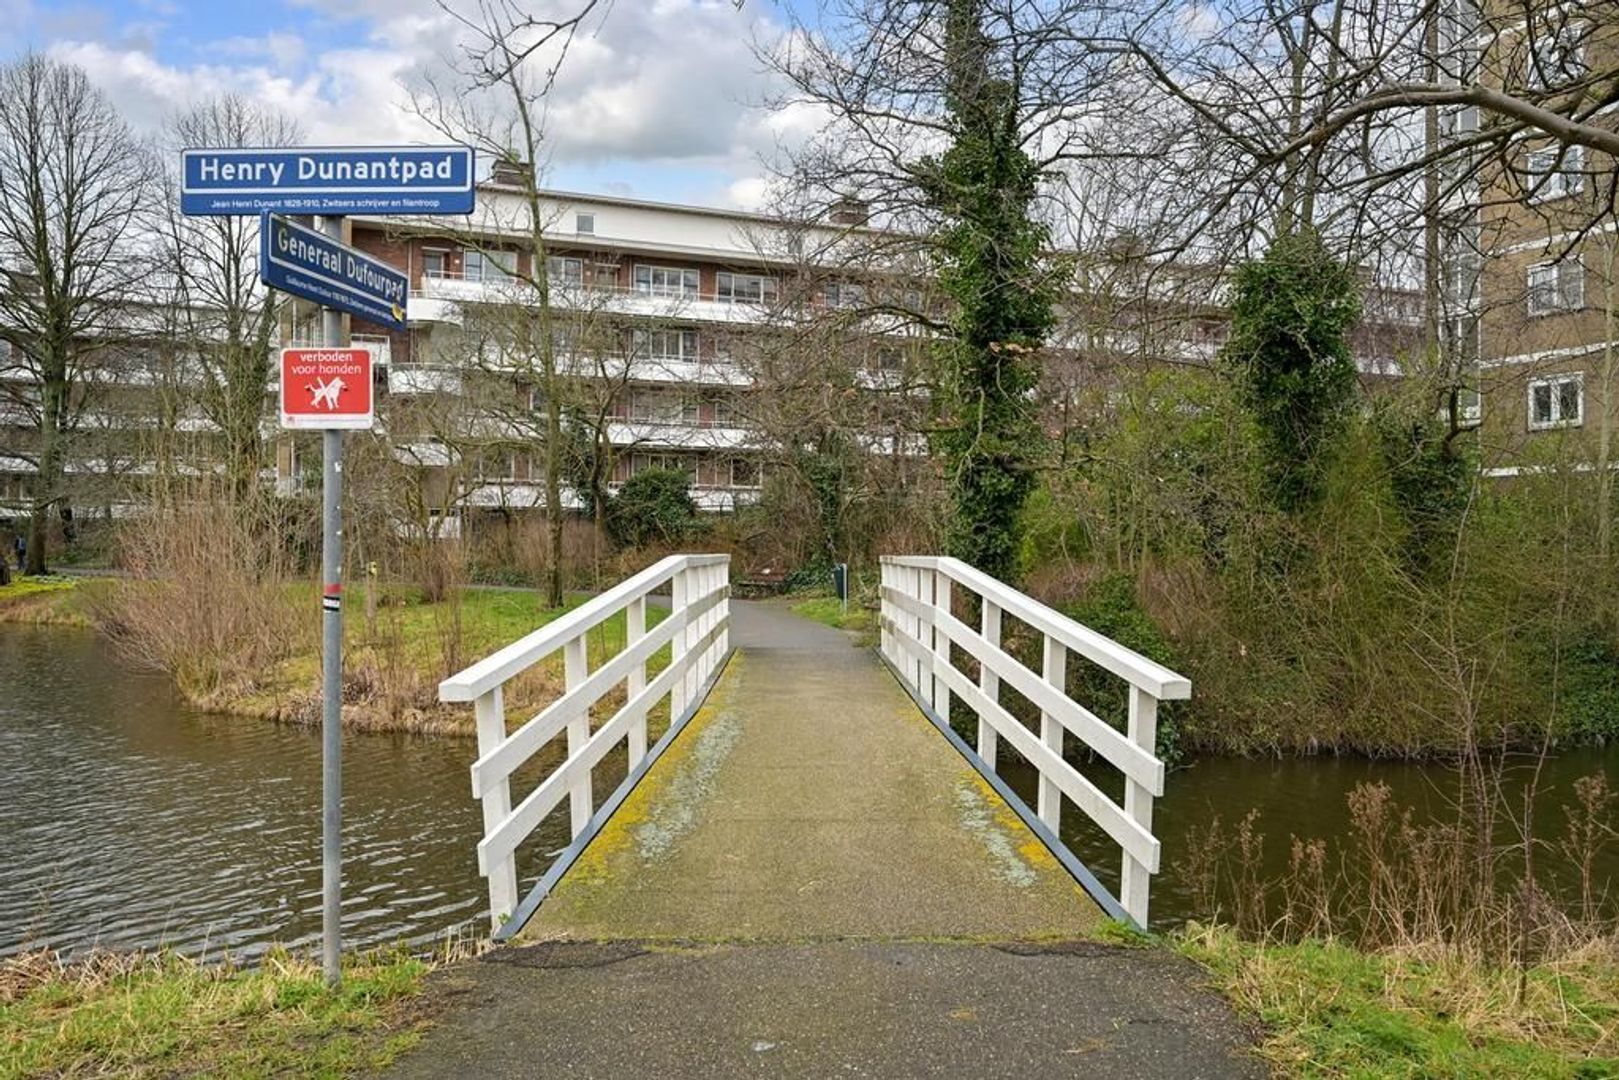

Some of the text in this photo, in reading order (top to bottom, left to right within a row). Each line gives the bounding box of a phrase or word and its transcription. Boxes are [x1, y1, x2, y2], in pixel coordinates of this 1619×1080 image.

[200, 155, 452, 185] Henry Dunantpad
[211, 199, 230, 208] Jean
[254, 199, 282, 209] Dunant
[322, 199, 355, 208] Zwitsers
[356, 199, 389, 208] schrijver
[391, 199, 401, 207] en
[277, 227, 342, 275] Generaal
[346, 256, 404, 301] Dufourpad
[299, 351, 353, 362] verboden
[291, 363, 362, 375] voor honden
